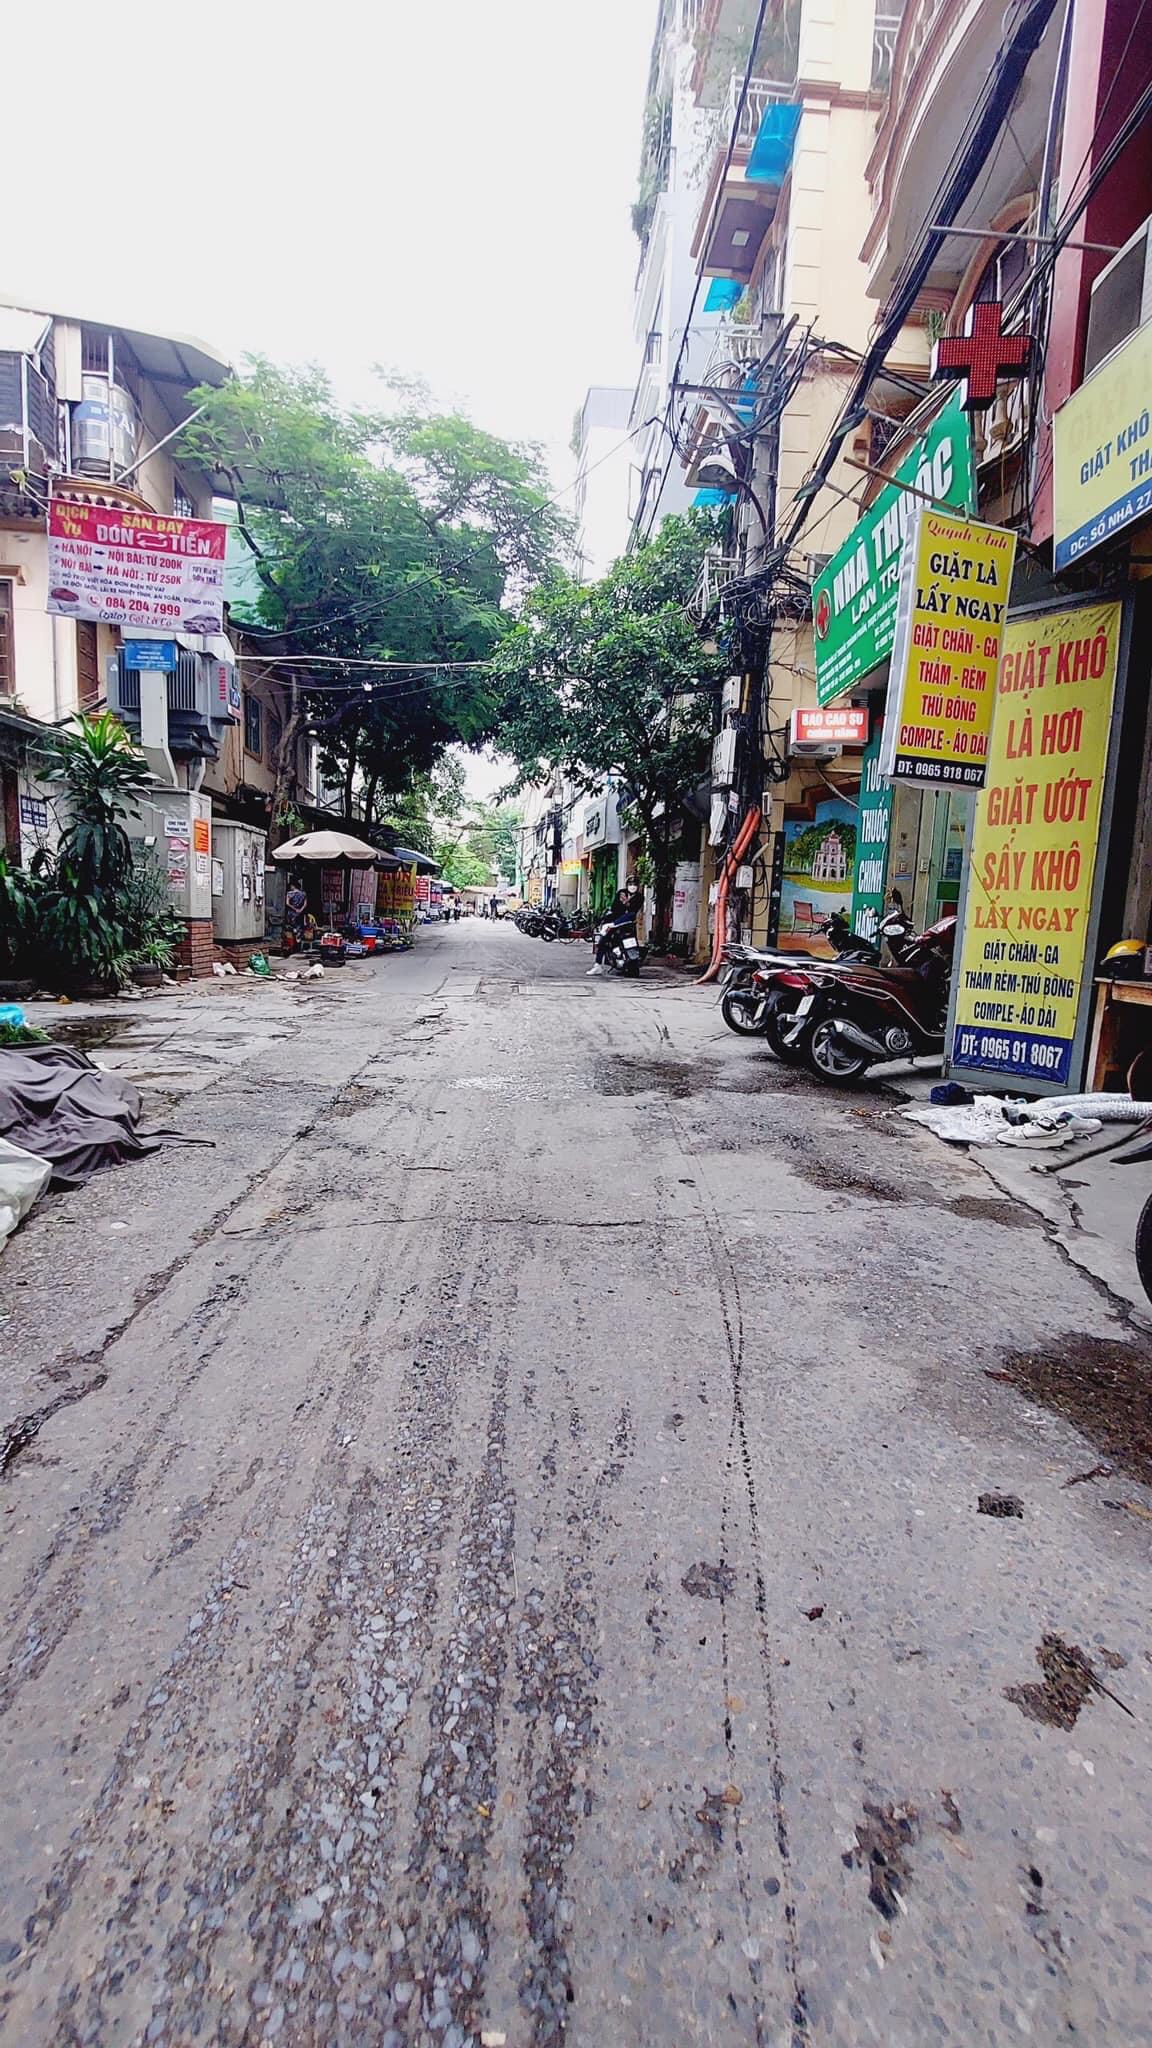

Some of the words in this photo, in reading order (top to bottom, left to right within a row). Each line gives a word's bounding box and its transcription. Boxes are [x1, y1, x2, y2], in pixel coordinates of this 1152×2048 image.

[1080, 443, 1112, 485] GIẶT
[1117, 409, 1150, 456] KHÔ
[96, 523, 134, 546] ĐÓN
[156, 519, 184, 534] BAY
[1091, 514, 1106, 541] SỐ
[1108, 500, 1133, 528] NHÀ
[106, 563, 120, 578] HÀ
[122, 566, 139, 582] NỘI
[160, 574, 182, 585] 250K
[108, 550, 127, 565] NỘI
[159, 559, 183, 570] 200K
[833, 537, 870, 616] NHÀ
[930, 551, 972, 583] GIẶT
[976, 559, 998, 586] LÀ
[106, 597, 126, 610] 084
[128, 599, 150, 613] 204
[153, 602, 181, 617] 7999
[852, 582, 877, 625] LAN
[915, 582, 952, 614] LẤY
[955, 596, 1004, 624] NGAY
[913, 622, 940, 652] GIẶT
[942, 629, 974, 654] CHĂN
[983, 637, 998, 658] GA
[920, 656, 951, 686] THẢM
[961, 665, 987, 692] RÈM
[999, 639, 1052, 700] GIẶT
[1055, 625, 1108, 685] KHÔ
[801, 713, 823, 726] BAO
[825, 713, 847, 726] CAO
[848, 713, 864, 726] SU
[921, 693, 944, 717] THÚ
[945, 695, 977, 722] BÔNG
[900, 725, 944, 750] COMPLE
[952, 728, 968, 754] ÁO
[970, 732, 988, 756] DÀI
[1006, 708, 1032, 760] LÀ
[1040, 707, 1084, 756] HƠI
[915, 762, 941, 778] 0965
[943, 766, 962, 780] 918
[964, 768, 984, 782] 067
[987, 776, 1038, 834] GIẶT
[1043, 768, 1092, 824] ƯỚT
[861, 797, 889, 843] THUỐC
[858, 852, 884, 894] CHÍNH
[983, 836, 1027, 891] SẤY
[1031, 840, 1081, 892] KHÔ
[974, 895, 1014, 930] LẤY
[1017, 906, 1080, 932] NGAY
[984, 939, 1006, 964] GIẶT
[1008, 940, 1038, 962] CHĂN
[1044, 945, 1059, 964] GA
[965, 963, 992, 990] THẢM
[1044, 974, 1075, 998] BÔNG
[974, 1001, 1014, 1024] COMPLE
[1037, 1004, 1057, 1028] DÀI
[980, 1036, 1010, 1060] 0965
[1012, 1040, 1026, 1064] 91
[1030, 1043, 1064, 1070] 8067
